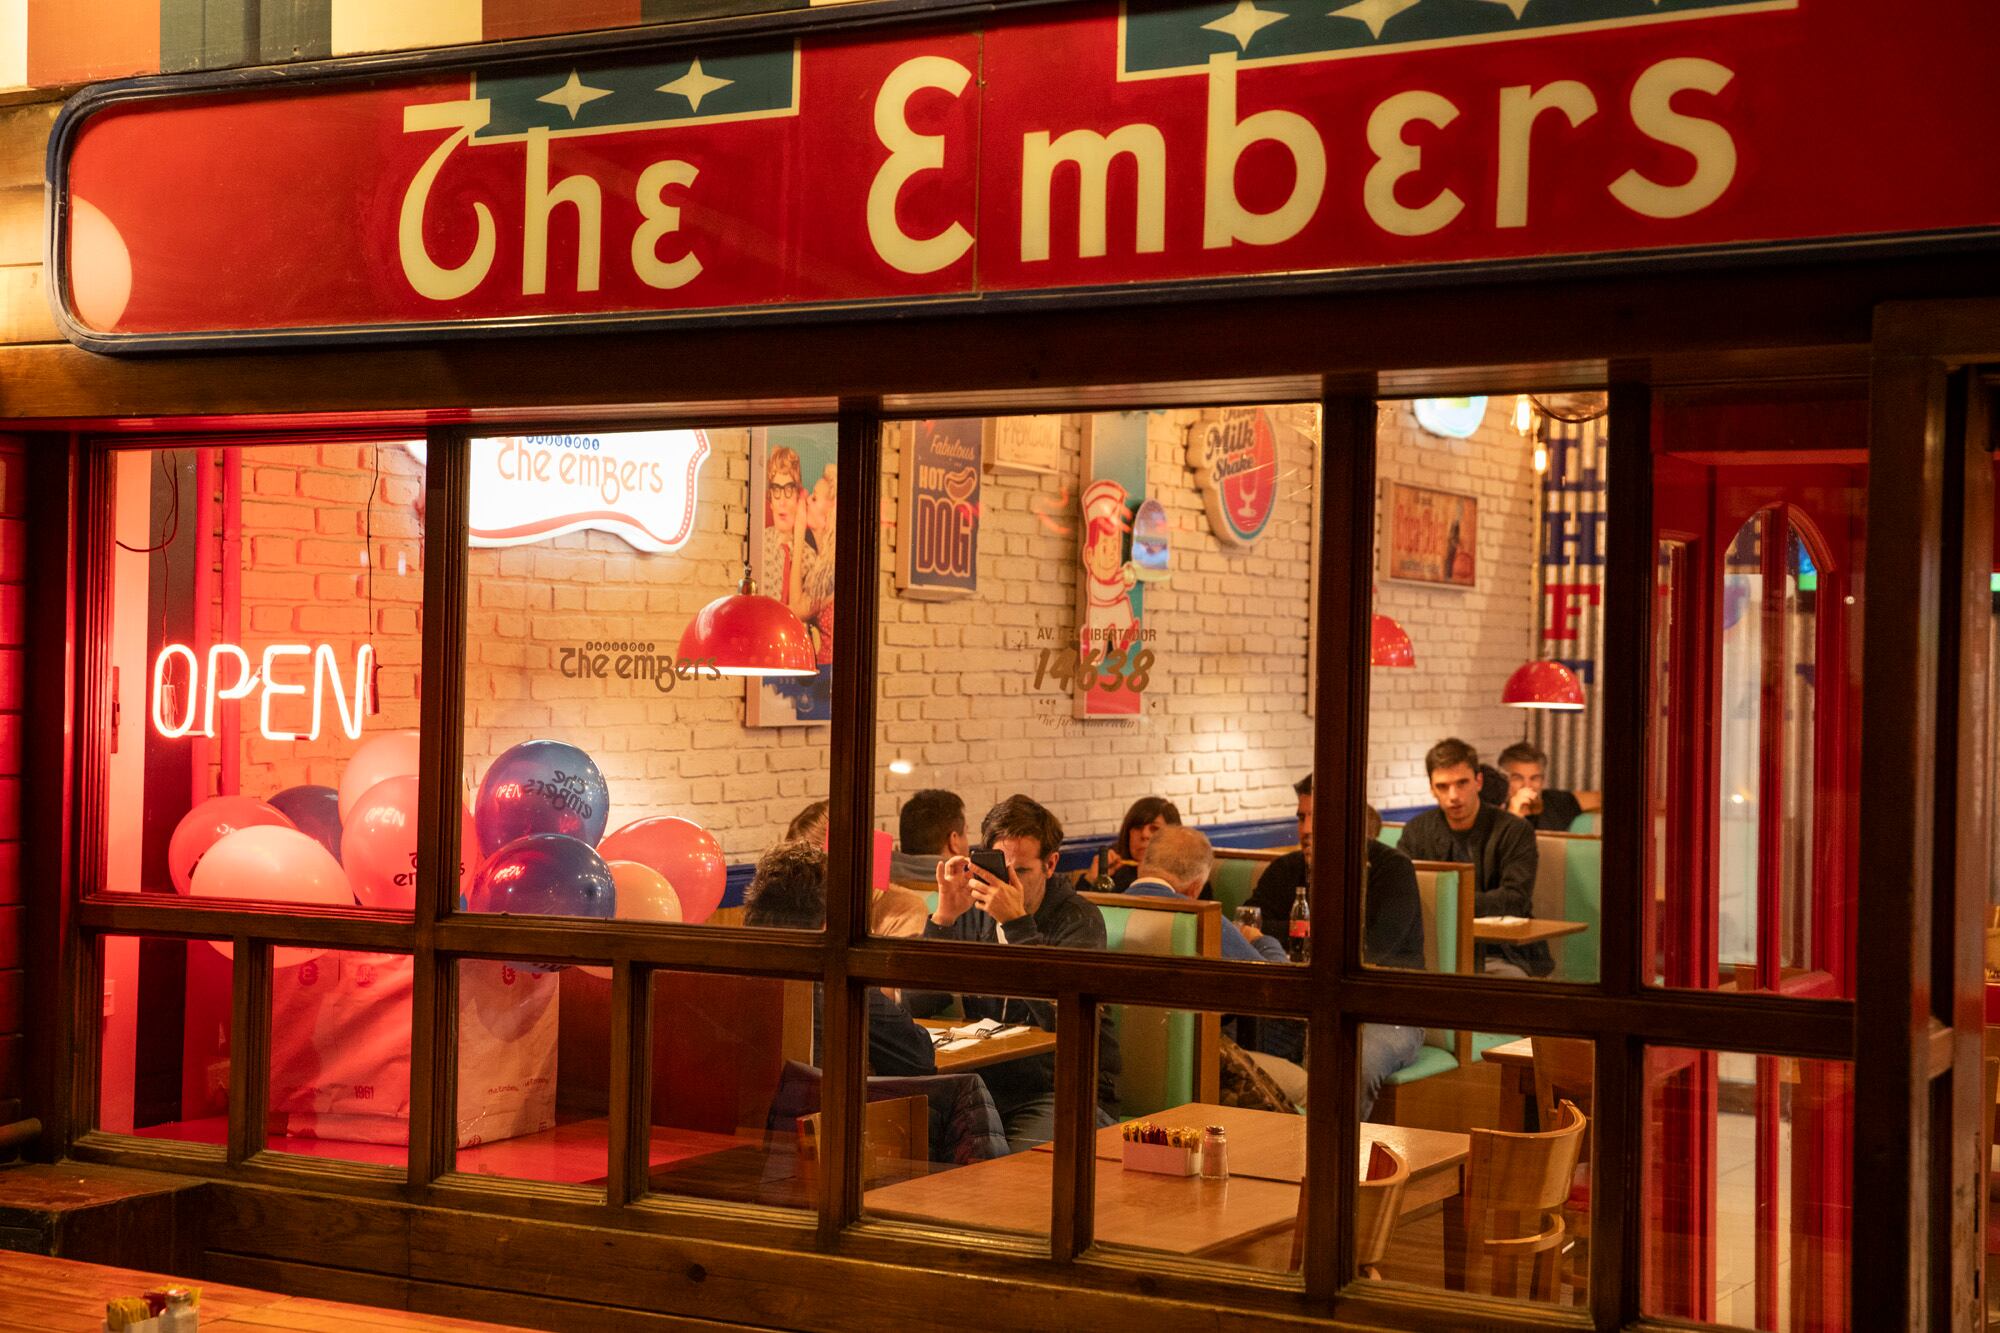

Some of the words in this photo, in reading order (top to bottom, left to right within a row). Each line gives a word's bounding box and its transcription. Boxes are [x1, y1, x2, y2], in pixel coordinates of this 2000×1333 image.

[399, 98, 704, 302] The
[866, 51, 1737, 274] Embers
[496, 438, 551, 482] The
[930, 433, 976, 461] Fabulous
[1205, 420, 1255, 461] Milk
[919, 464, 946, 491] HOT
[916, 494, 972, 577] DOG
[1036, 627, 1055, 641] AV.
[1084, 628, 1157, 642] IBERTADOR
[559, 647, 609, 679] The
[1033, 647, 1156, 693] 14638
[152, 643, 373, 741] OPEN
